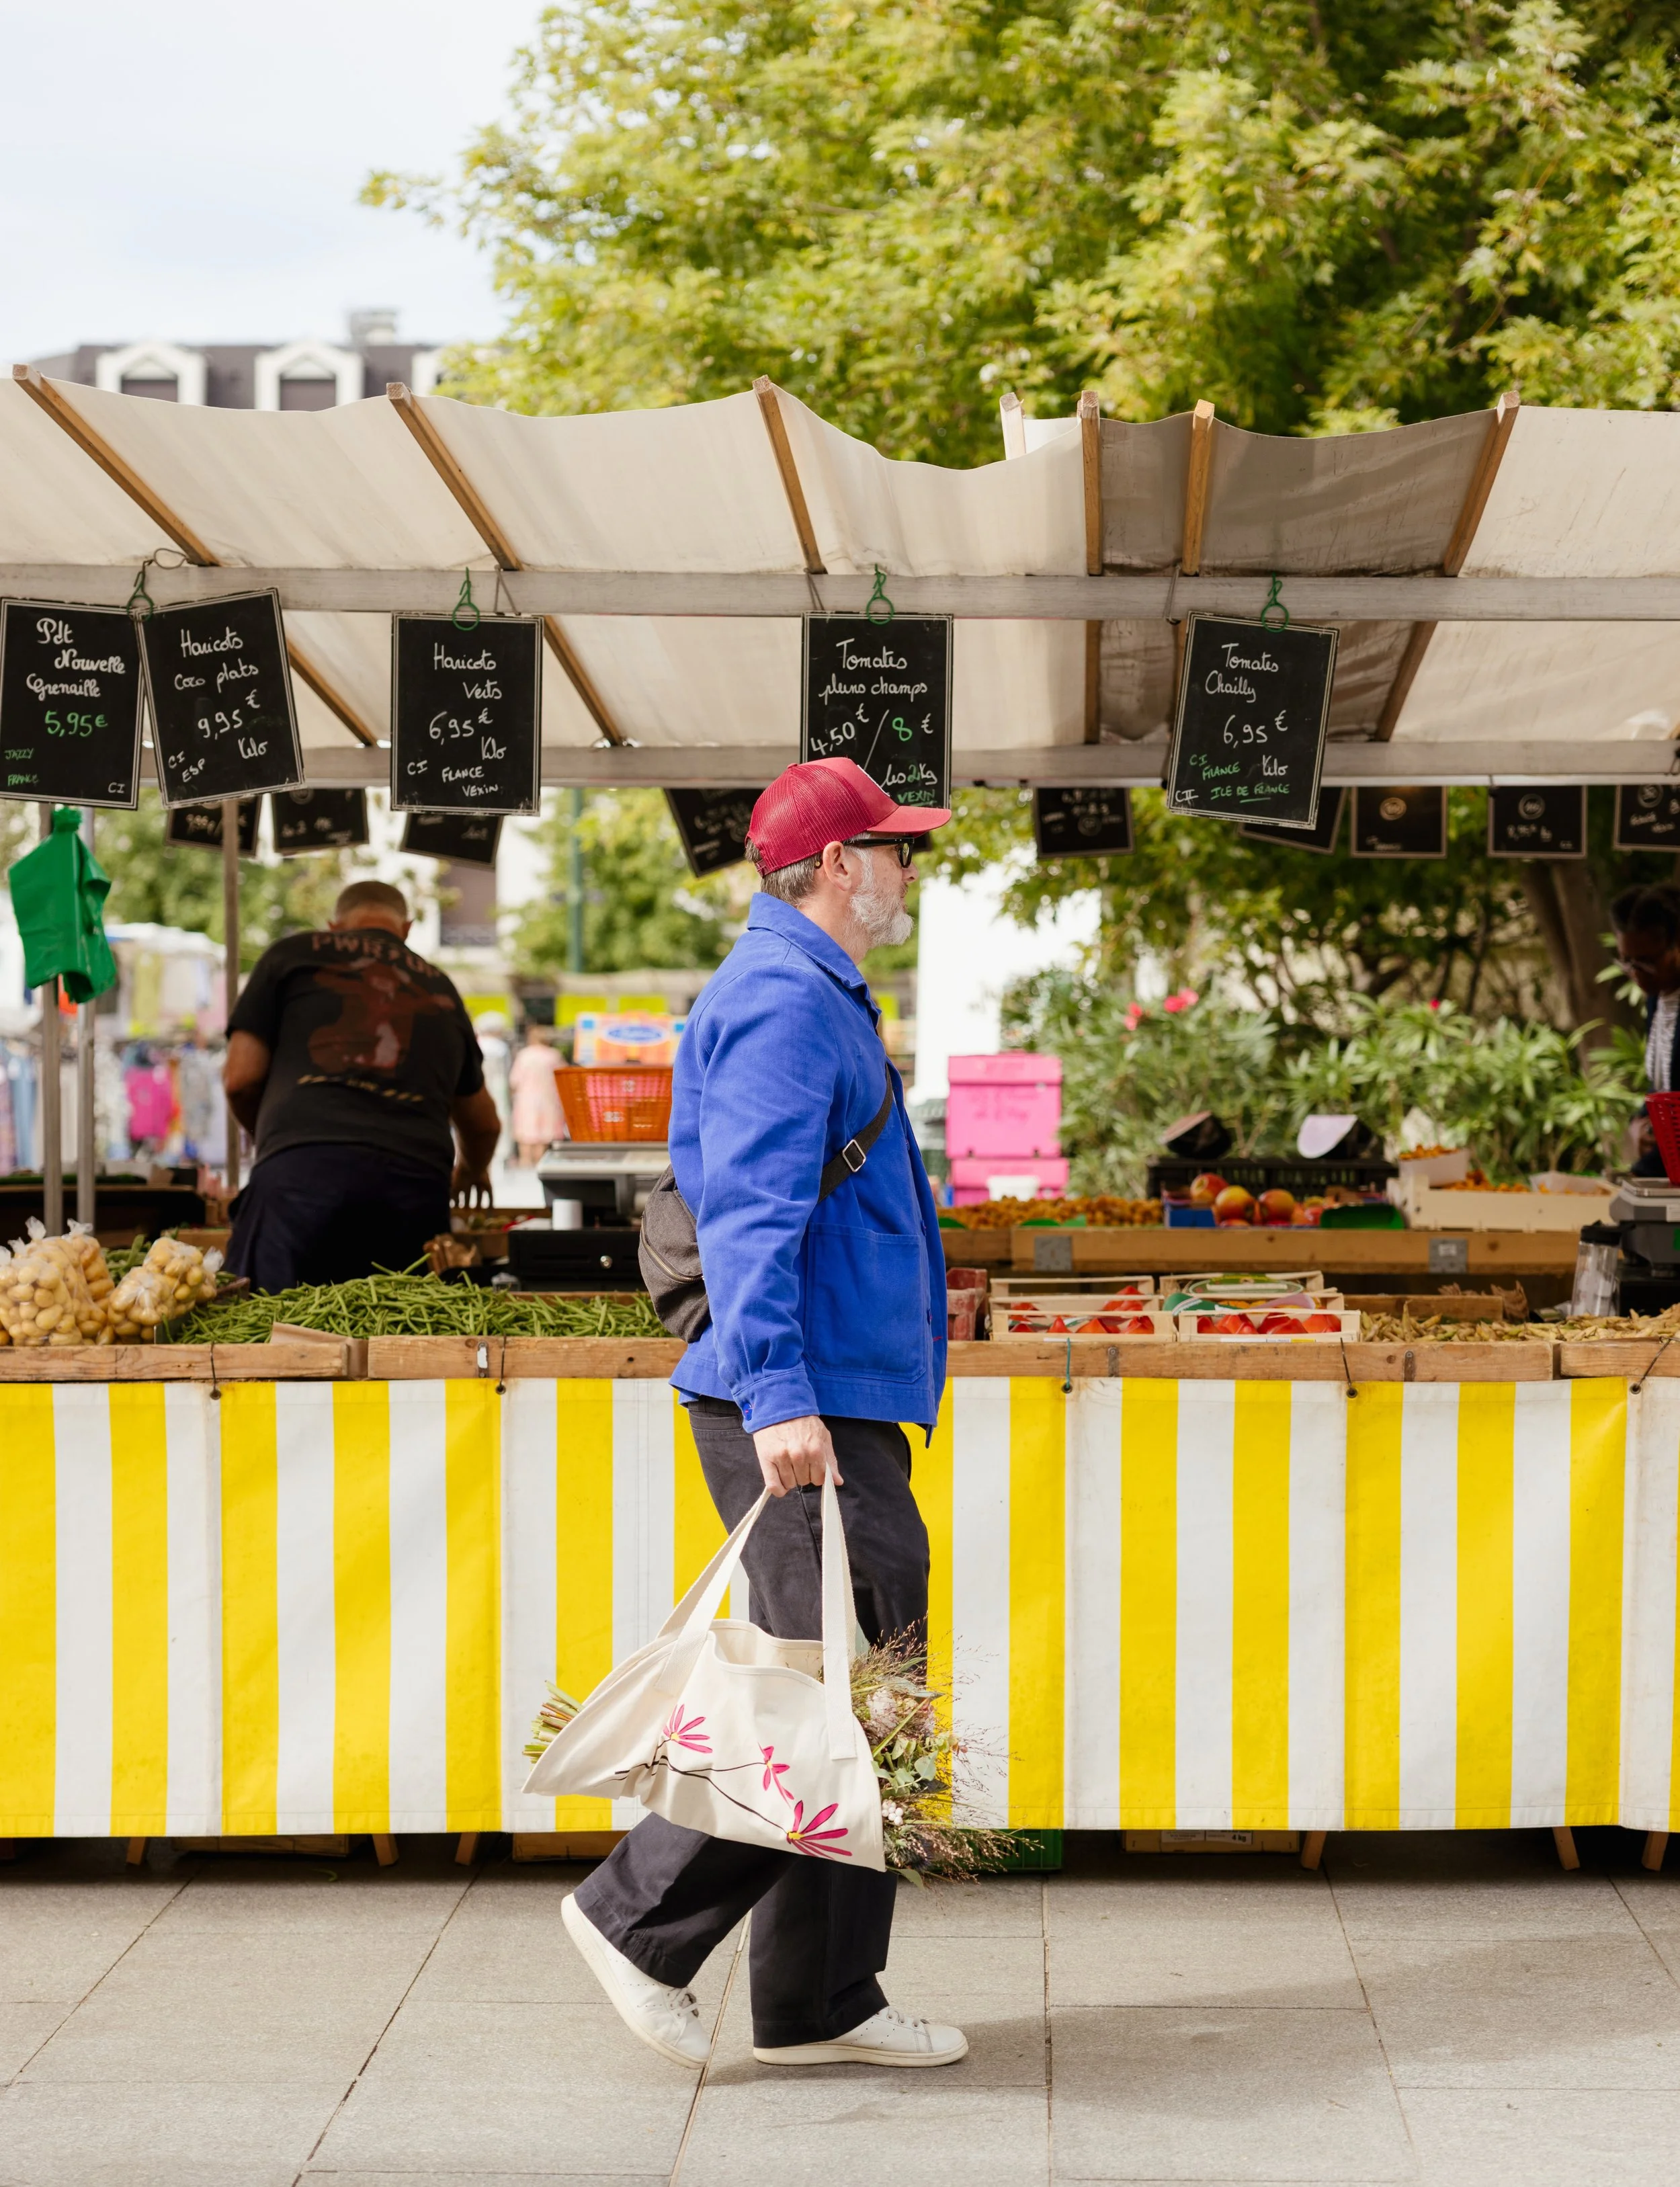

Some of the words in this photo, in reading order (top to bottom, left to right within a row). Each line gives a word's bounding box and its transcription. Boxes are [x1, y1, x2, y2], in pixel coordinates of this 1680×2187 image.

[36, 617, 74, 645] Pdt
[180, 626, 243, 658] Haricots
[54, 649, 126, 674] Nouvelle
[433, 642, 497, 670] Haricots
[835, 638, 908, 670] Tomates
[1222, 643, 1279, 673] Tomates
[26, 673, 101, 702] Grenaille
[216, 657, 259, 694] plats
[871, 675, 927, 702] champs
[1205, 669, 1256, 703] Chailly
[462, 679, 502, 700] Verts
[44, 710, 108, 737] 5,95€
[181, 757, 206, 783] ESP
[108, 782, 125, 794] CI
[897, 789, 935, 803] VEXIN
[1236, 785, 1249, 797] DE
